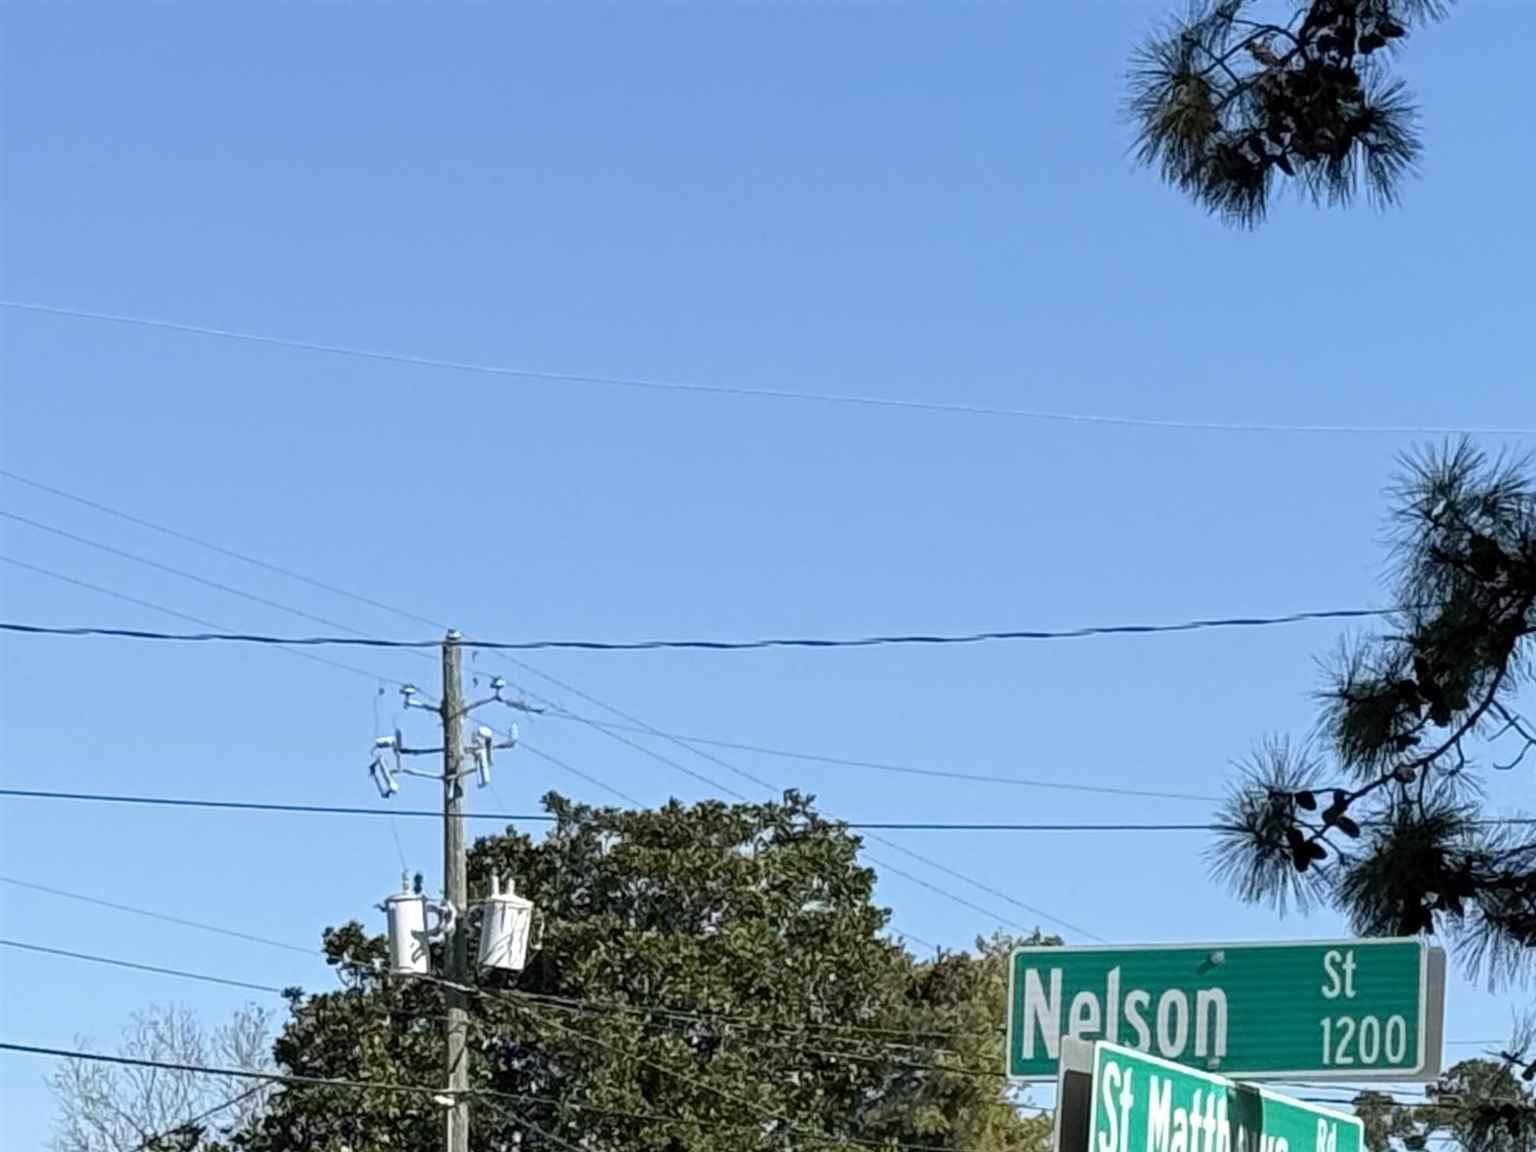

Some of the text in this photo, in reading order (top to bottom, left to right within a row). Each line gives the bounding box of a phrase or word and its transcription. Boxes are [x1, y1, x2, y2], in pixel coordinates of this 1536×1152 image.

[1021, 950, 1357, 1059] Nelson St
[1321, 1015, 1406, 1065] 1200
